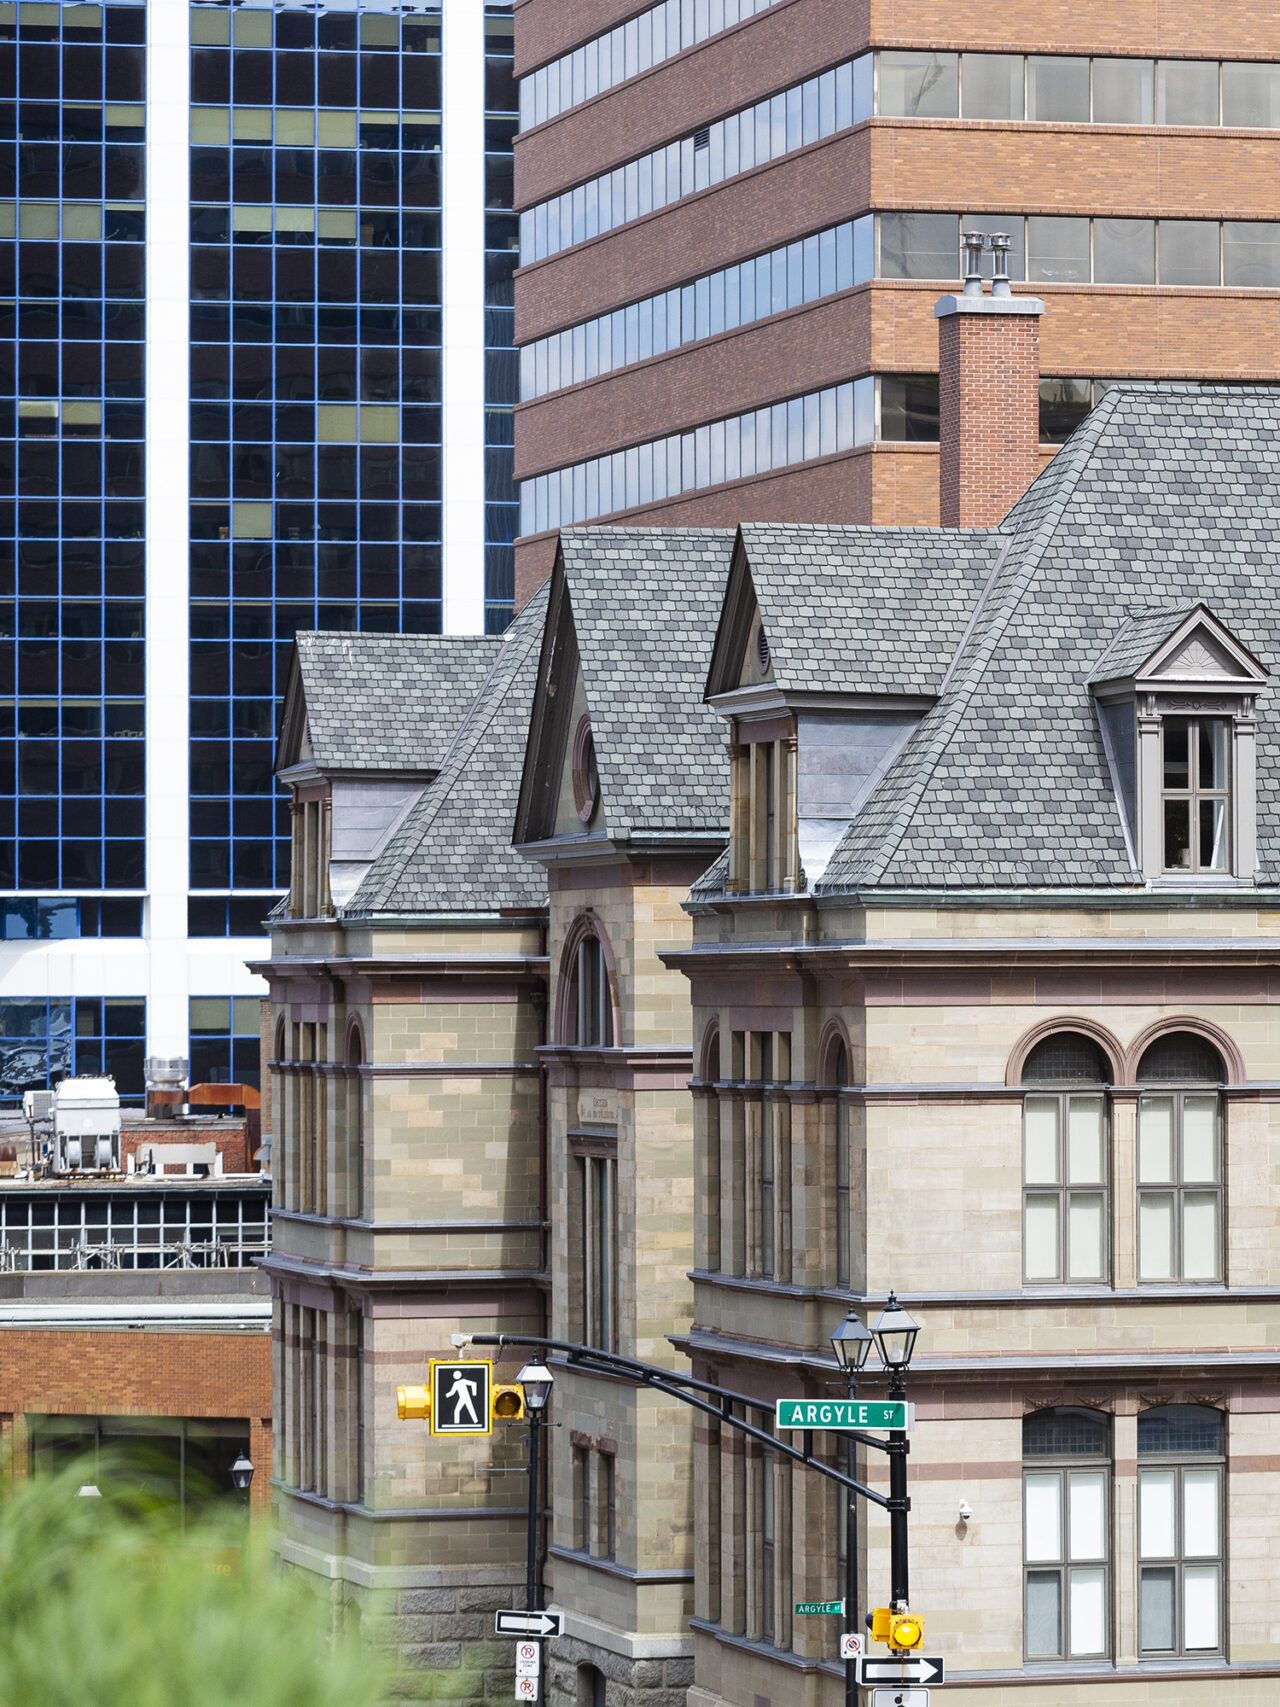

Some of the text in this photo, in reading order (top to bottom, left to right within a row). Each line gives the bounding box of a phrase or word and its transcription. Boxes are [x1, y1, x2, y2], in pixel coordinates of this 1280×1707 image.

[791, 1405, 894, 1423] ARGYLE ST
[798, 1604, 831, 1613] ARGYLE
